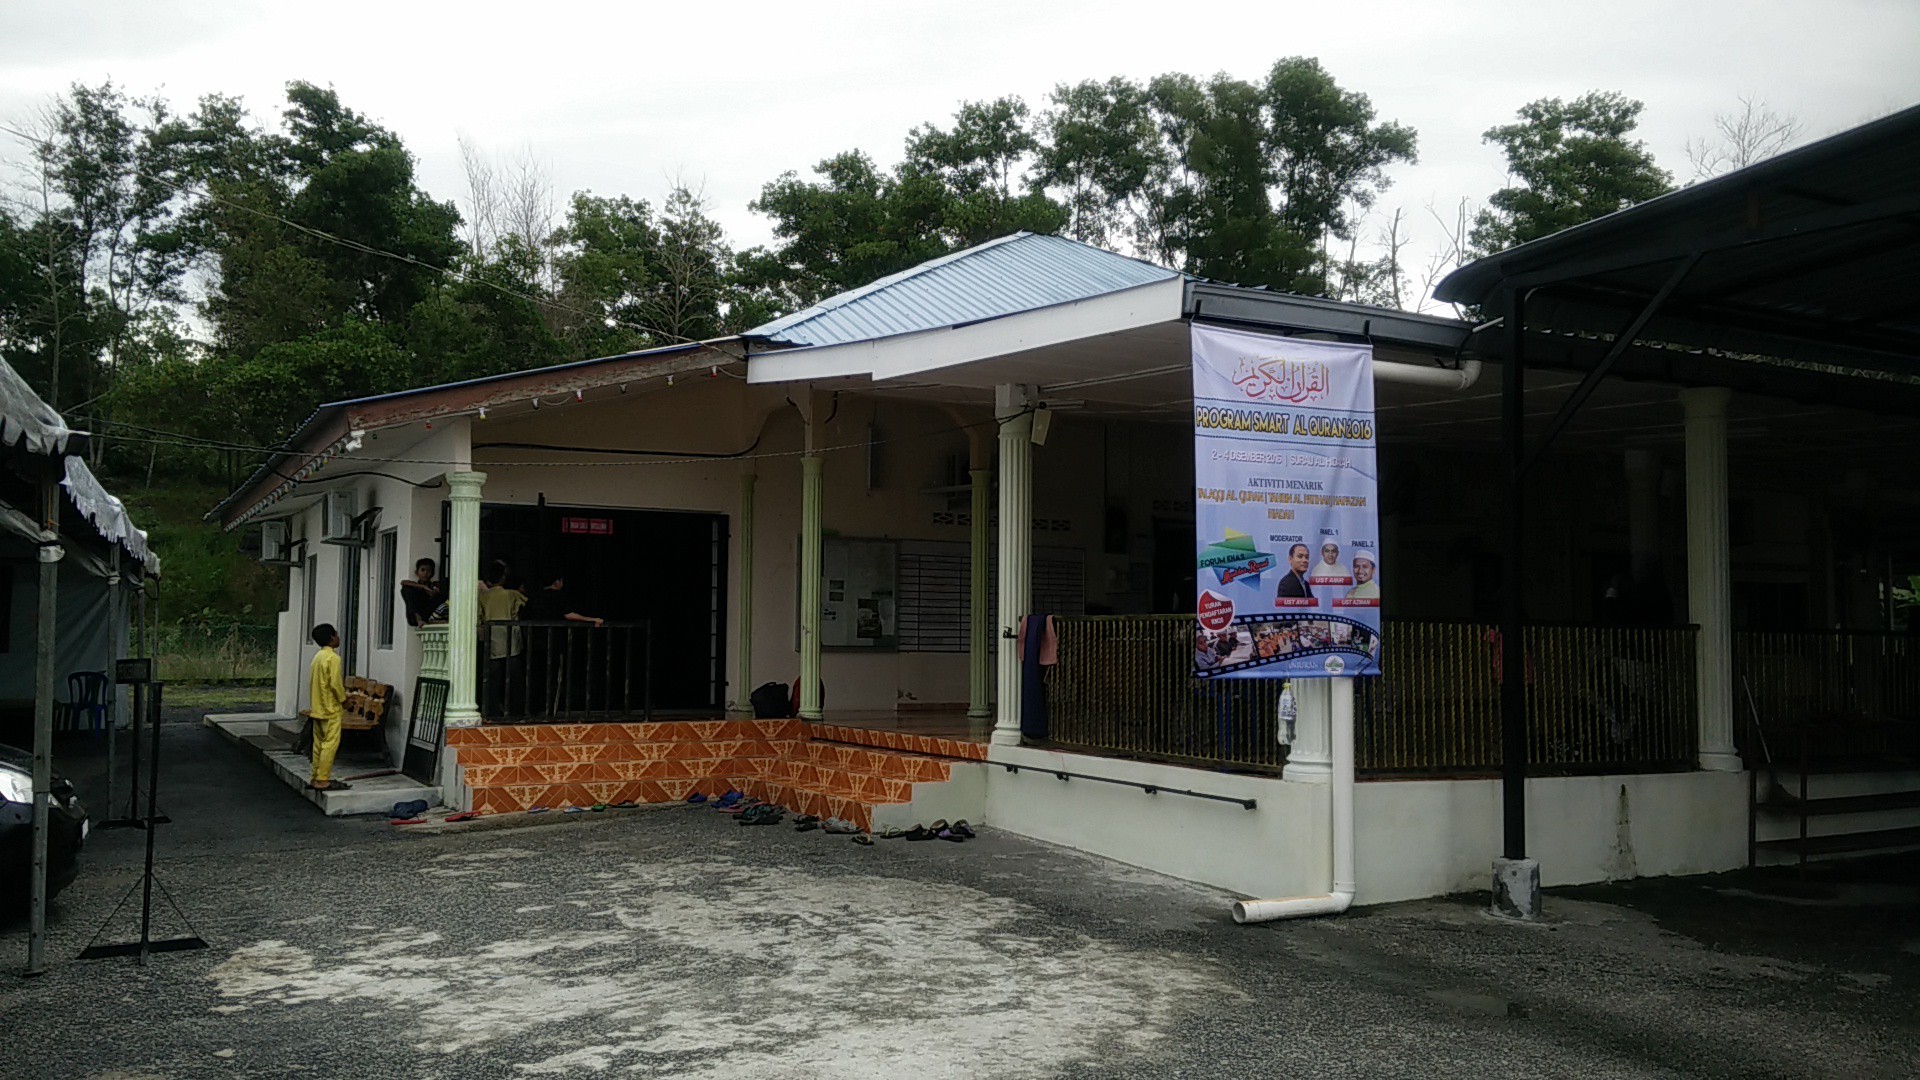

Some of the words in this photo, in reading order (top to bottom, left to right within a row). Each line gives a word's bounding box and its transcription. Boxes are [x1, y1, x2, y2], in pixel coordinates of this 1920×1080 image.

[1196, 406, 1251, 432] PROGRAM
[1253, 411, 1289, 434] SMART
[1293, 415, 1307, 436] AL
[1308, 414, 1346, 438] QURAN
[1346, 417, 1372, 439] 2016
[1247, 478, 1284, 489] AKTIVITI
[1286, 480, 1324, 490] MENARIK
[1270, 534, 1303, 542] MODERATOR
[1200, 556, 1226, 568] FORUM
[1226, 553, 1246, 563] KHAS
